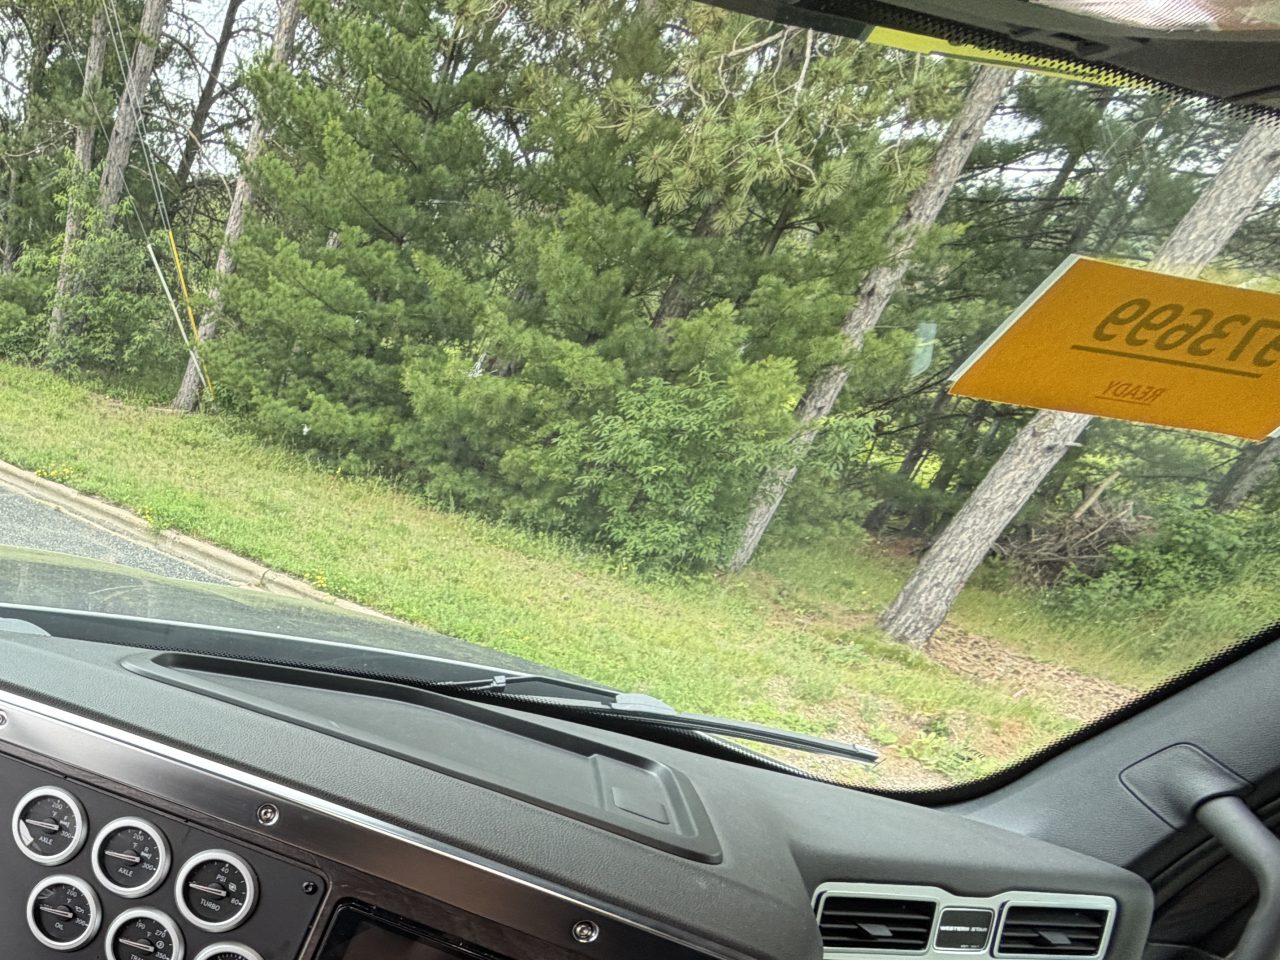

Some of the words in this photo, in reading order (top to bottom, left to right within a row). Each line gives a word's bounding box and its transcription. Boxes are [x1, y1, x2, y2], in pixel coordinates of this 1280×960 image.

[60, 830, 72, 839] 300
[132, 833, 144, 841] 200
[38, 835, 54, 846] AXLE
[142, 862, 153, 871] 300
[118, 867, 134, 878] AXLE
[216, 873, 227, 882] PSI
[66, 889, 78, 898] 200
[200, 898, 221, 912] TURBO
[75, 917, 86, 926] 300
[54, 922, 64, 931] OIL
[154, 929, 166, 938] 270
[155, 951, 167, 960] 350
